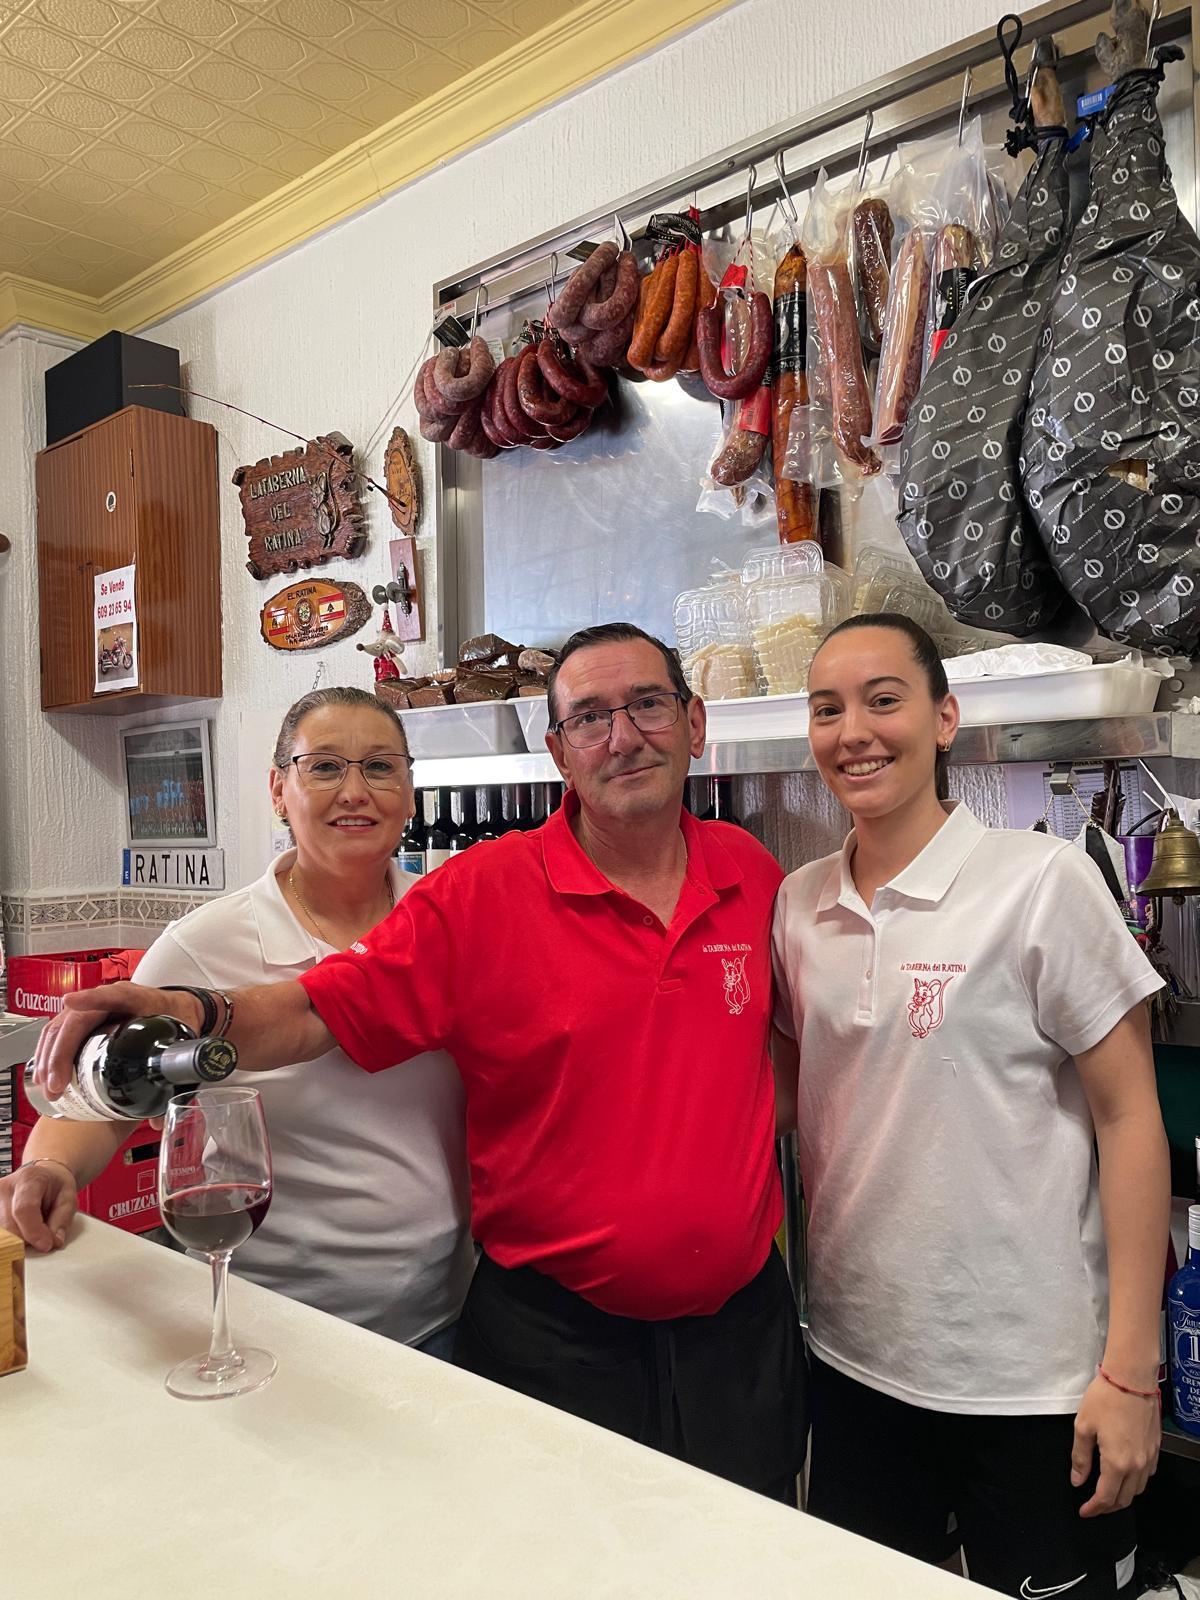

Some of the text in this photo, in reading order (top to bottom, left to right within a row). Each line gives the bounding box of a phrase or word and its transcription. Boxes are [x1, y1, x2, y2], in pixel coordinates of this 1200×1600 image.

[264, 529, 303, 552] RATINA
[101, 579, 124, 595] Se Vende
[287, 586, 317, 600] EL RATINA
[136, 854, 210, 885] RATINA
[906, 963, 931, 971] TABERNA
[932, 963, 940, 971] del
[942, 963, 967, 972] RATINA
[15, 987, 64, 1013] Cruzcam
[108, 1192, 160, 1218] CRUZCA
